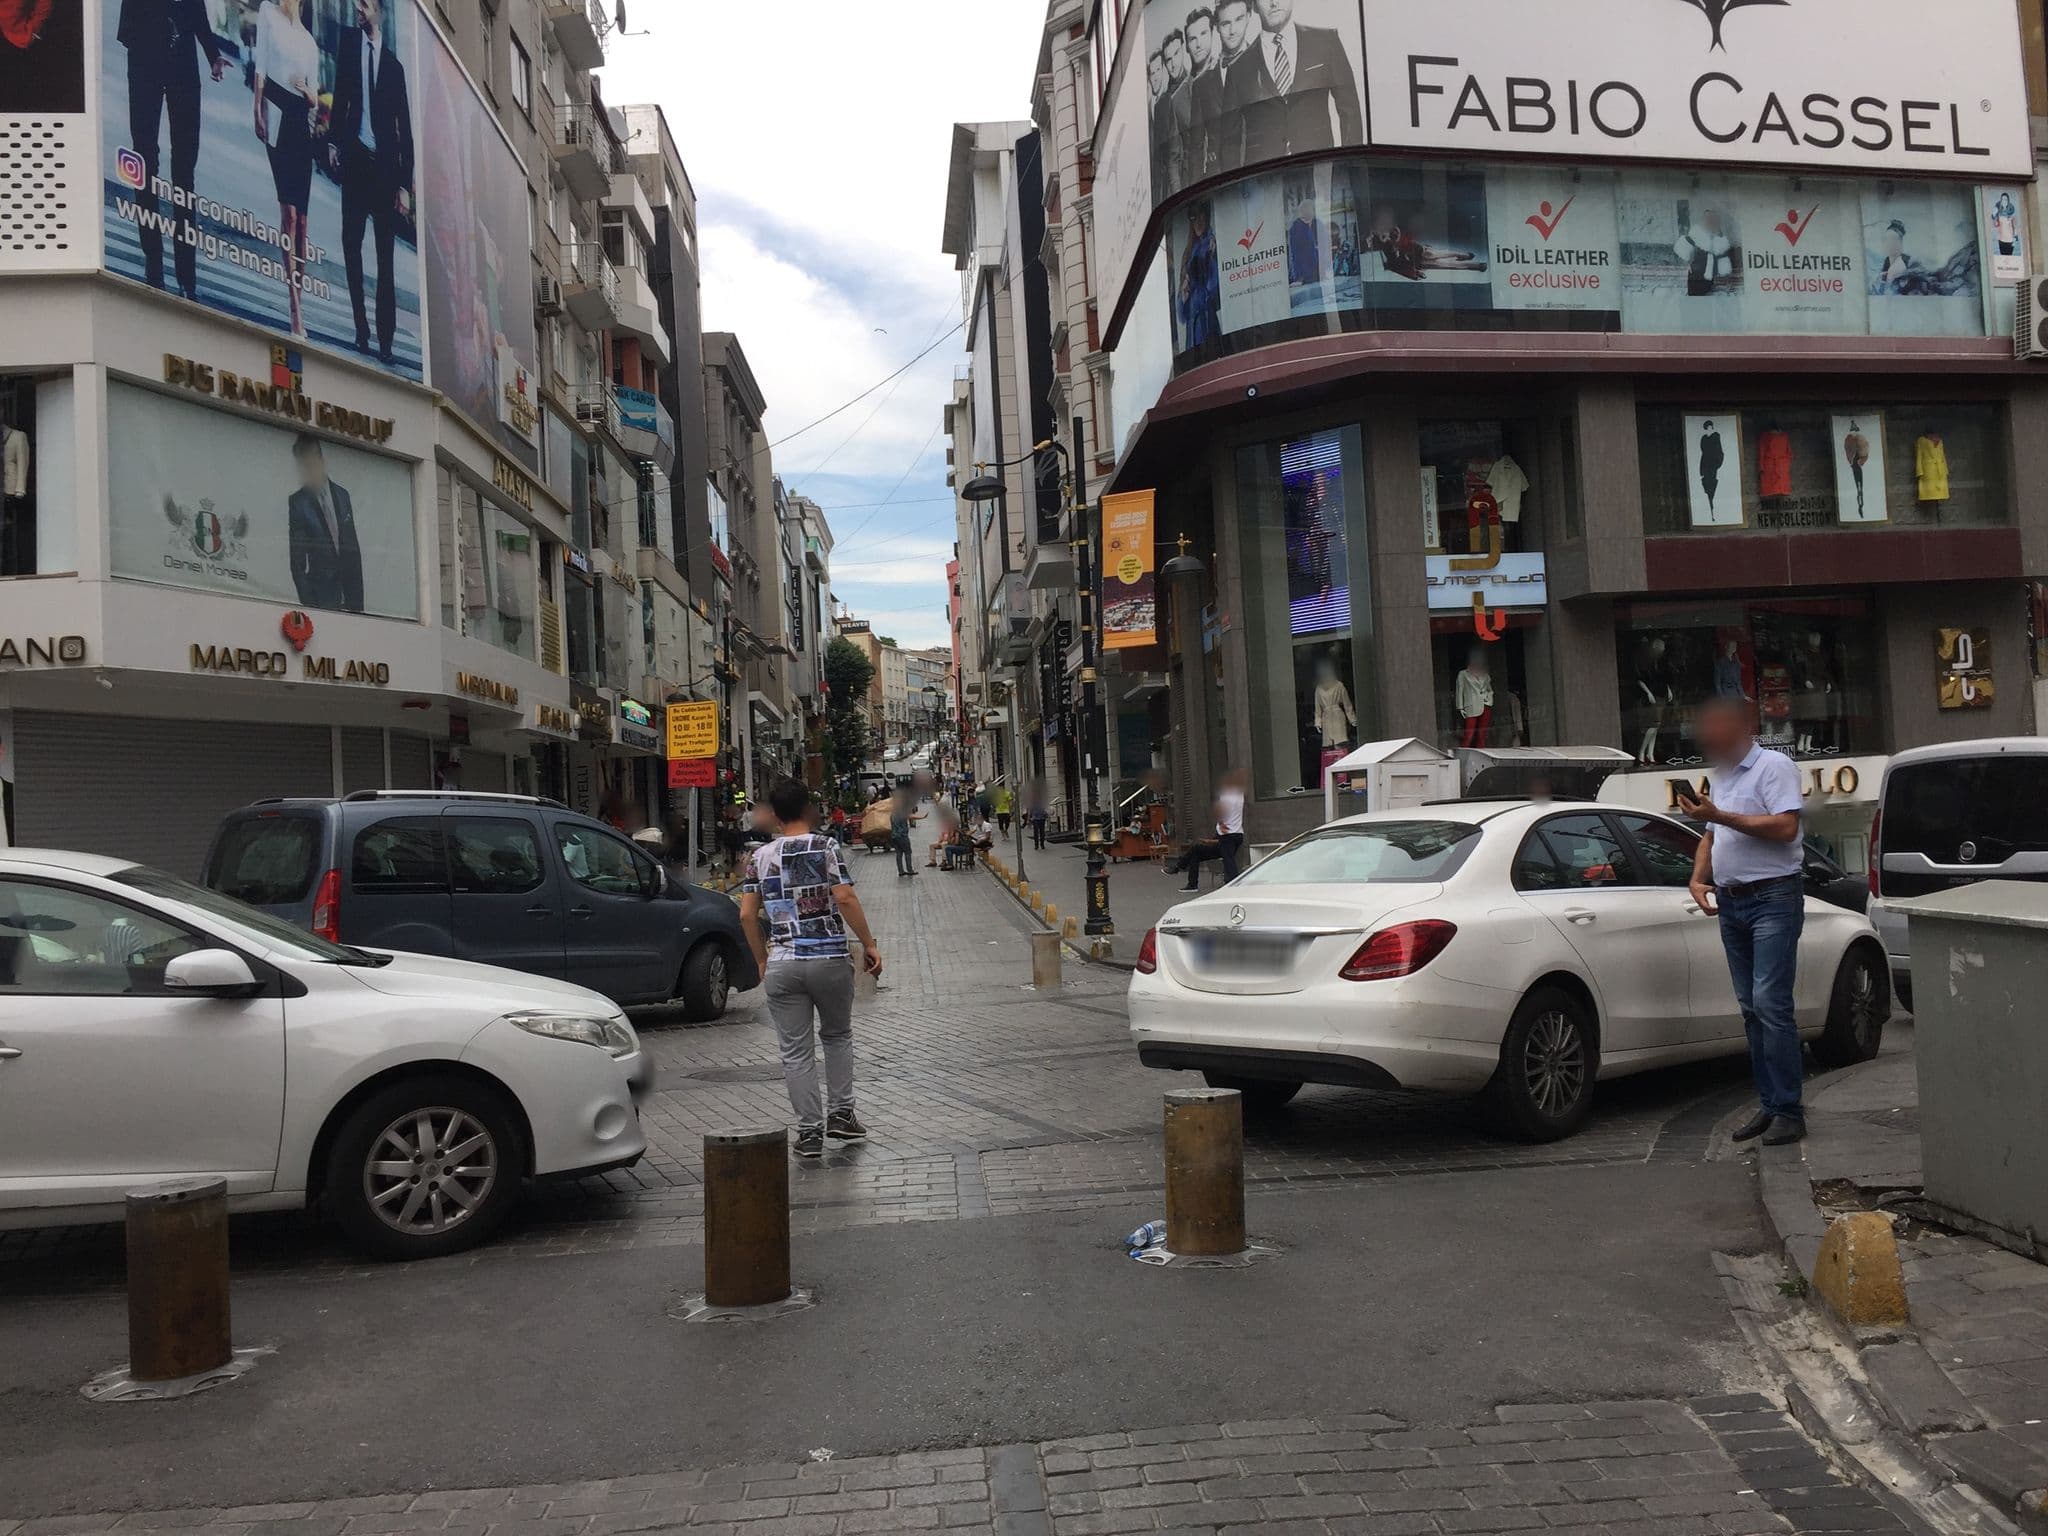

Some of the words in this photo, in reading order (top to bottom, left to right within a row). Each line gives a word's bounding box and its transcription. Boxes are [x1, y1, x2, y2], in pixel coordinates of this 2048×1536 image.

[1407, 54, 1647, 140] FABIO
[1690, 72, 1990, 157] CASSEL
[151, 174, 327, 266] marcomilano_br
[115, 195, 332, 301] www.bigraman.com
[1242, 245, 1285, 266] LEATHER
[1496, 244, 1530, 264] İDİL
[1534, 248, 1610, 267] LEATHER
[1229, 260, 1281, 282] exclusive
[1747, 250, 1780, 270] İDİL
[1783, 254, 1852, 272] LEATHER
[1508, 269, 1601, 289] exclusive
[1760, 273, 1844, 293] exclusive
[841, 621, 869, 629] WEAVER
[190, 643, 288, 676] MARCO
[303, 654, 390, 685] MILANO
[673, 725, 683, 733] 10
